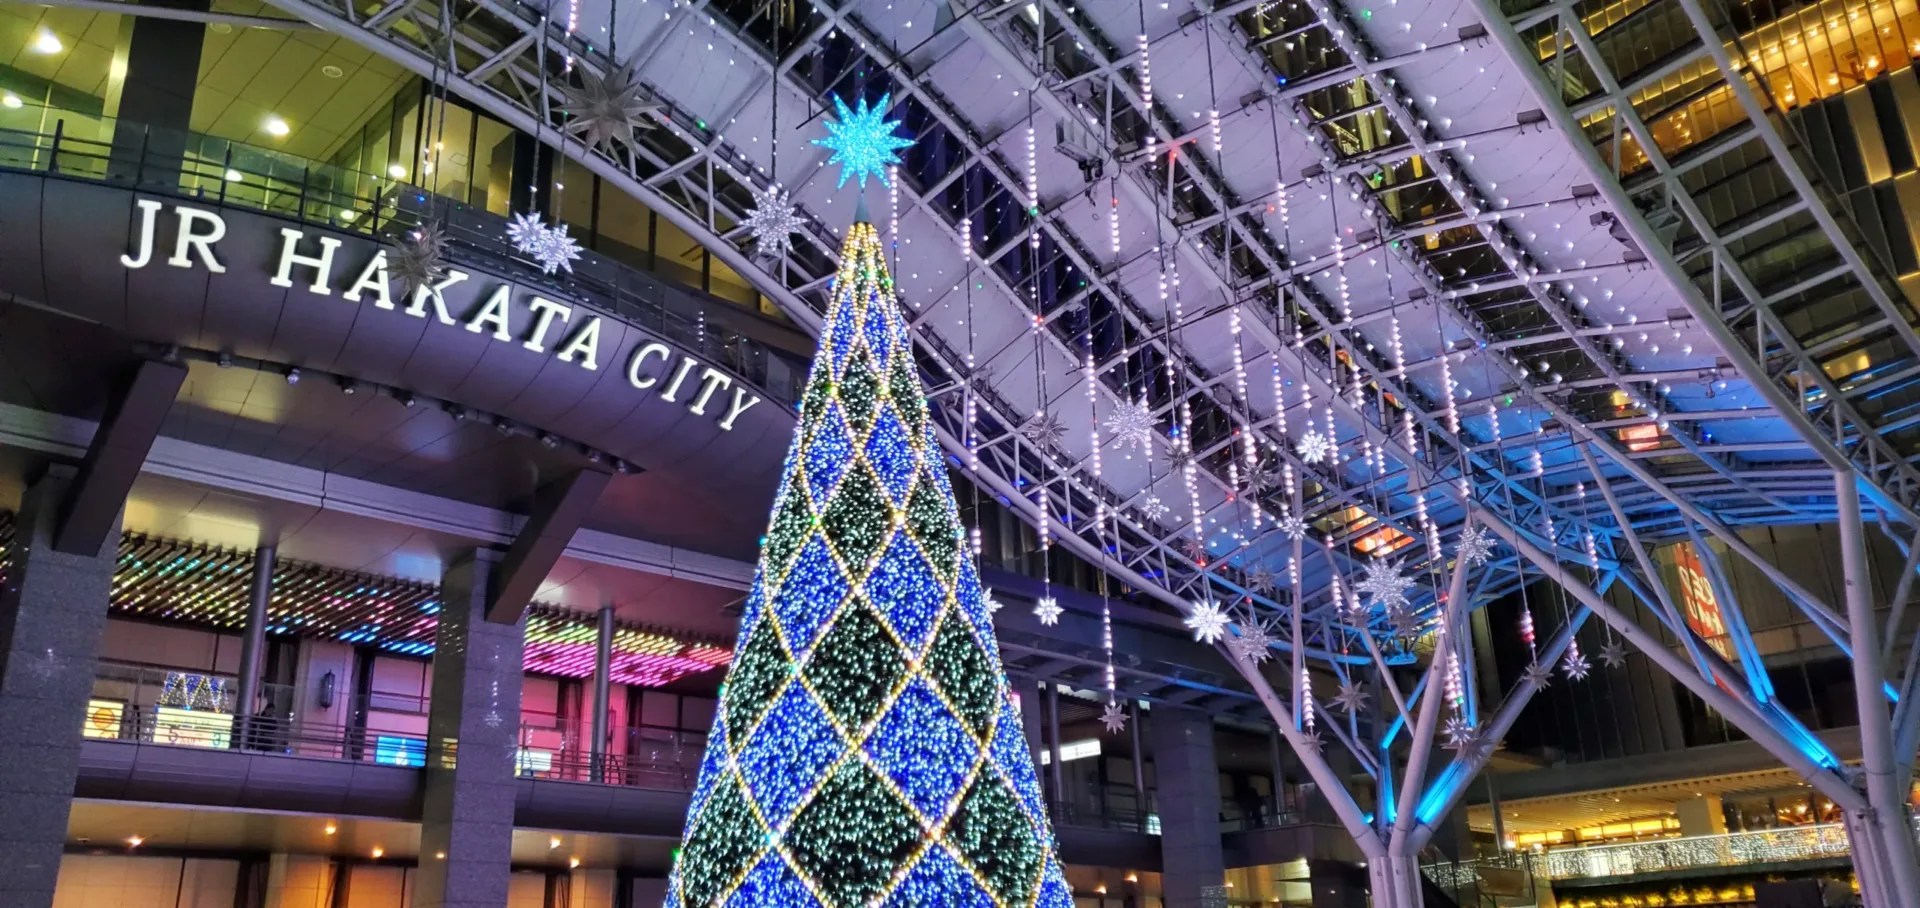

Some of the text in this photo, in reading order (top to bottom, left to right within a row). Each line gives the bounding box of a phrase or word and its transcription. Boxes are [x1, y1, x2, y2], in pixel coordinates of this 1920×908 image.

[120, 199, 761, 431] JR HAKATA CITY
